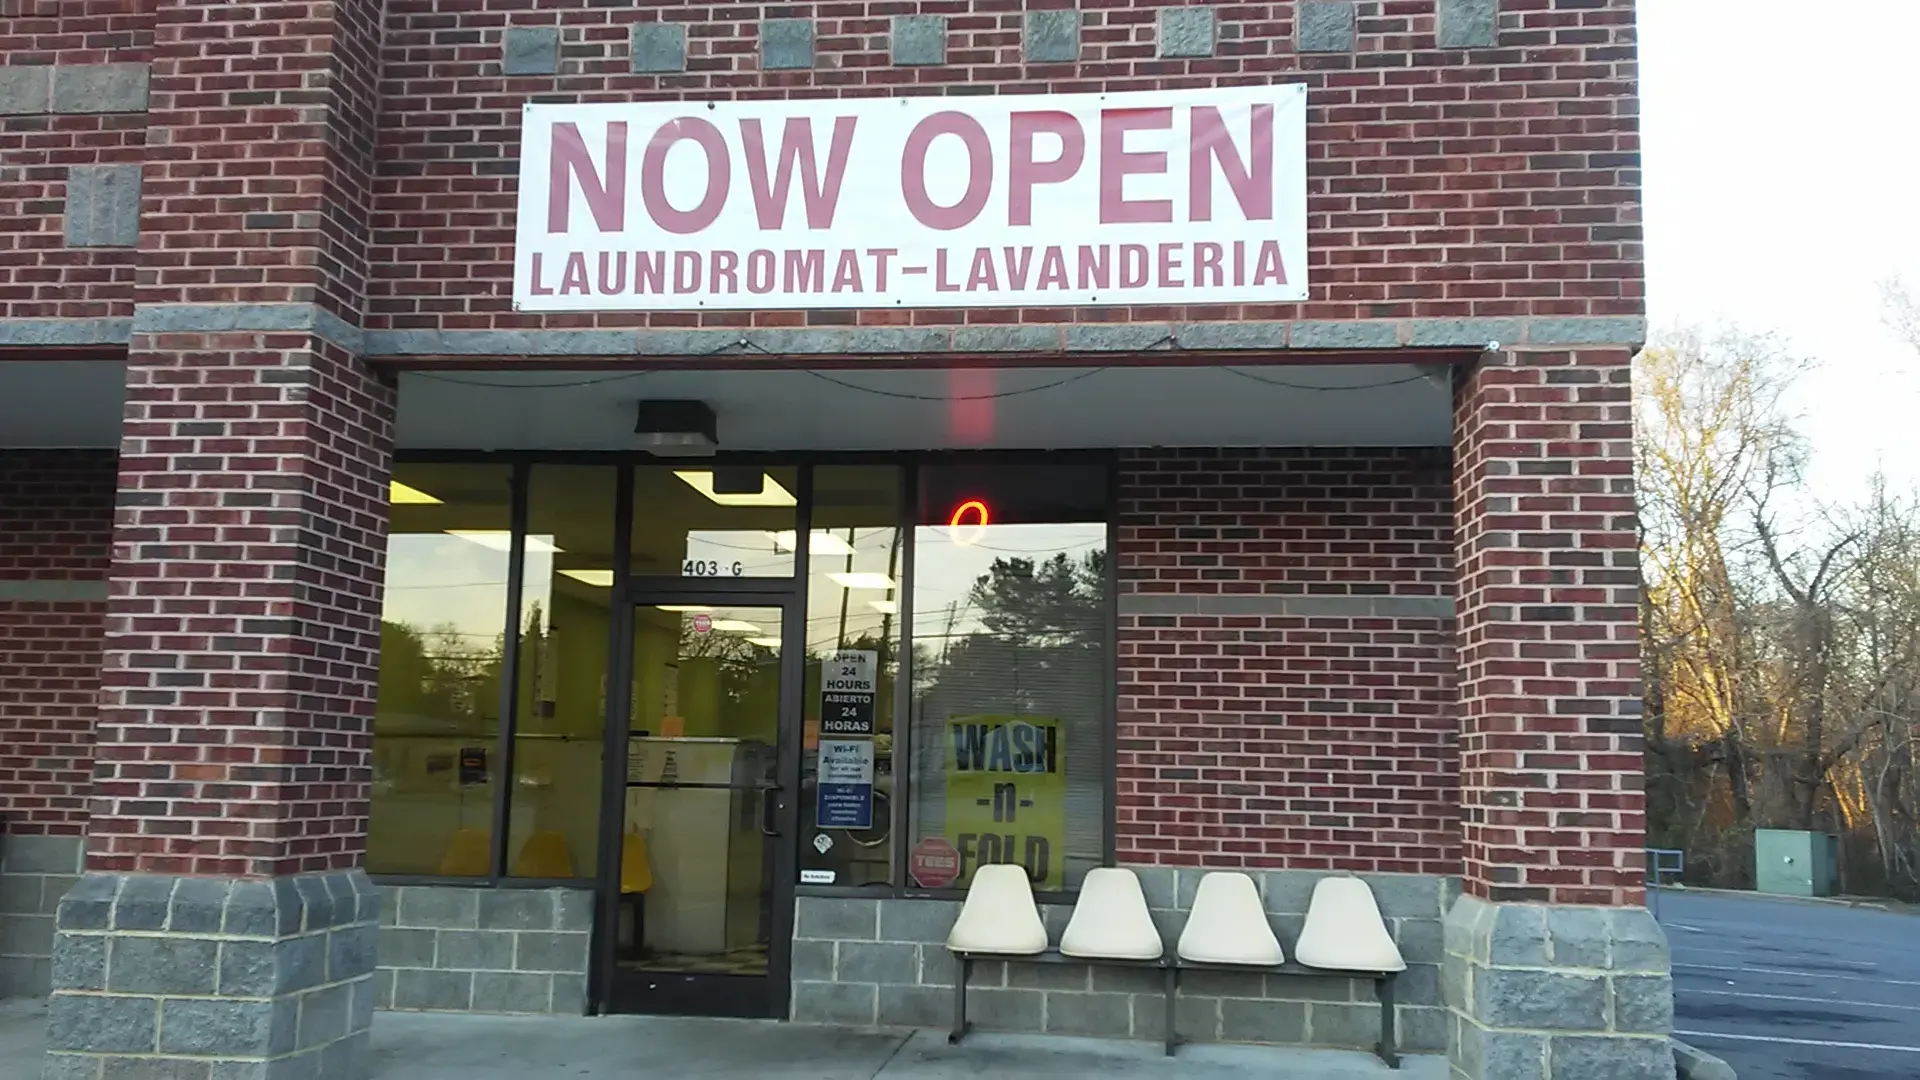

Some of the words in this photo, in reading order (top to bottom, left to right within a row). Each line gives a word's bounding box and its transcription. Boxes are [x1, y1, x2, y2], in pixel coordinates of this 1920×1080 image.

[547, 115, 858, 234] NOW
[901, 103, 1274, 230] OPEN
[530, 240, 1288, 296] LAUNDROMAT-LAVANDERIA
[833, 653, 867, 664] OPEN
[841, 666, 857, 676] 24
[826, 680, 871, 690] HOURS
[824, 694, 872, 704] ABIERTO
[841, 706, 858, 717] 24
[824, 720, 870, 731] HORAS
[833, 745, 859, 753] Wi-Fi
[953, 724, 1056, 773] WASH
